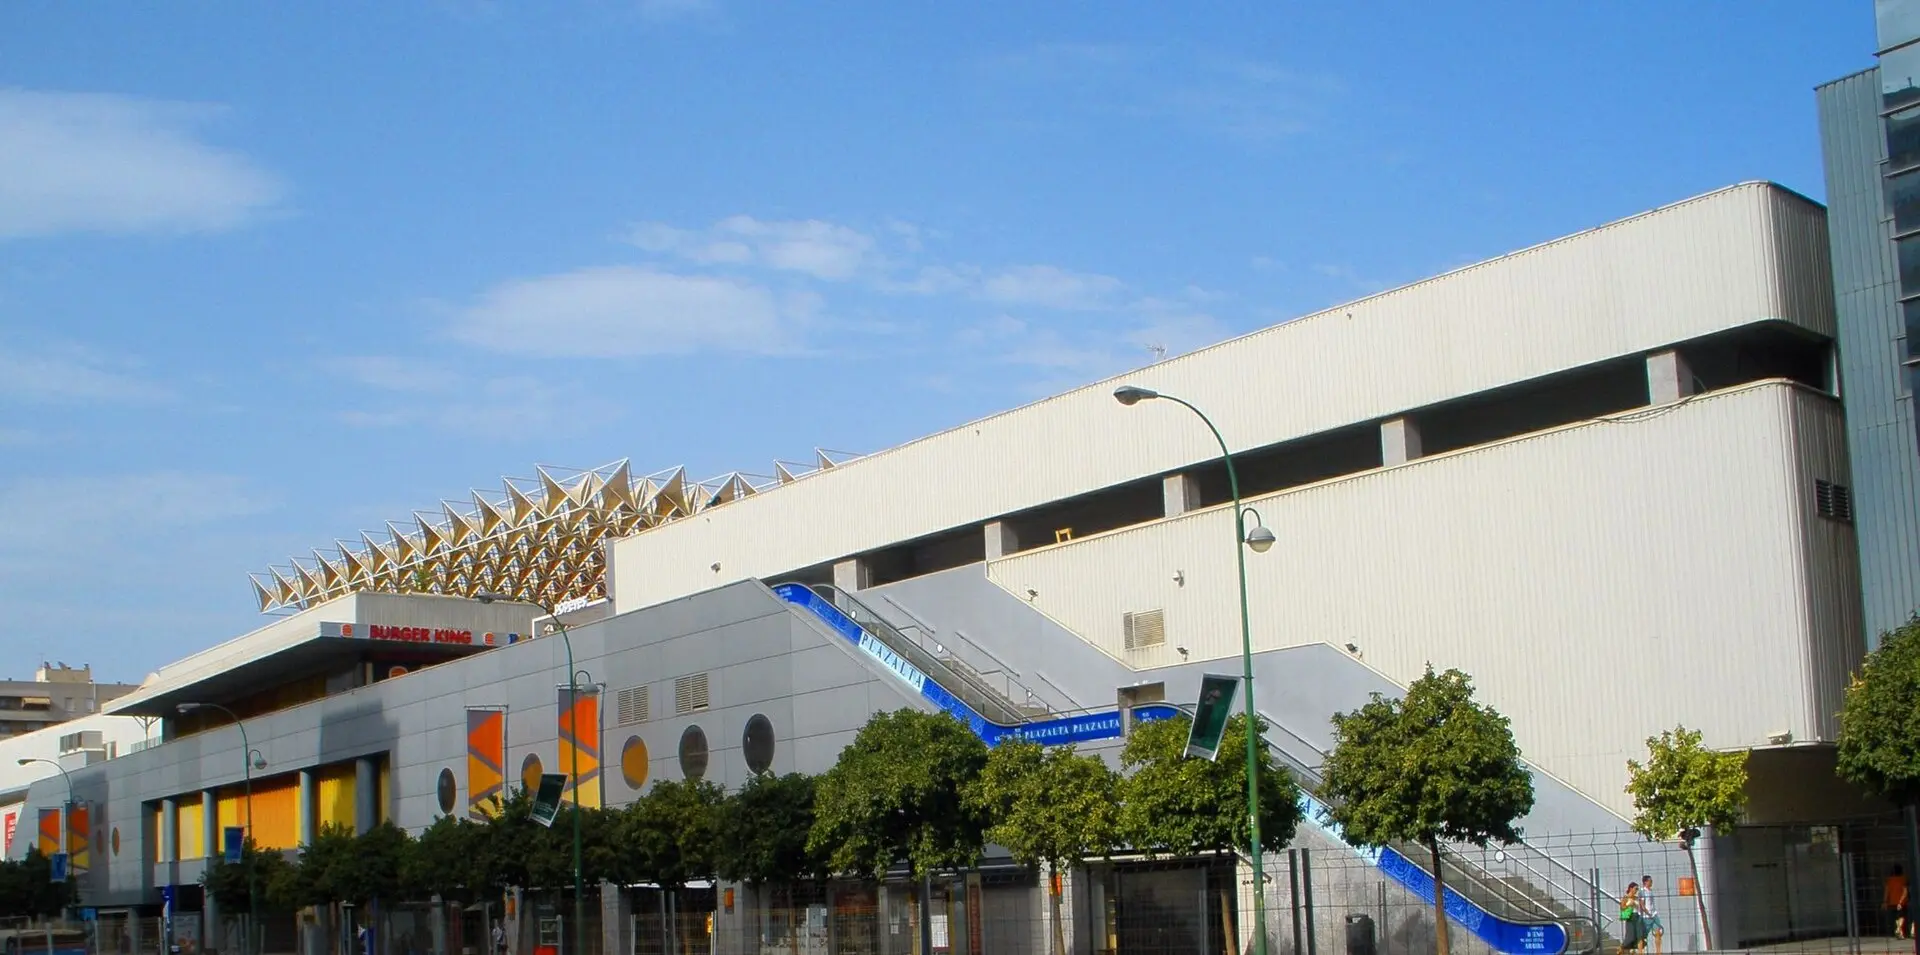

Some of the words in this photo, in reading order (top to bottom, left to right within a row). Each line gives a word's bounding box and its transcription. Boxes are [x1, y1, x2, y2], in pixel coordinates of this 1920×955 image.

[369, 624, 431, 642] BURGER
[434, 628, 473, 644] KING
[861, 633, 922, 688] PLAZALTA
[1024, 726, 1069, 740] PLAZALTA
[1073, 719, 1120, 733] PLAZALTA
